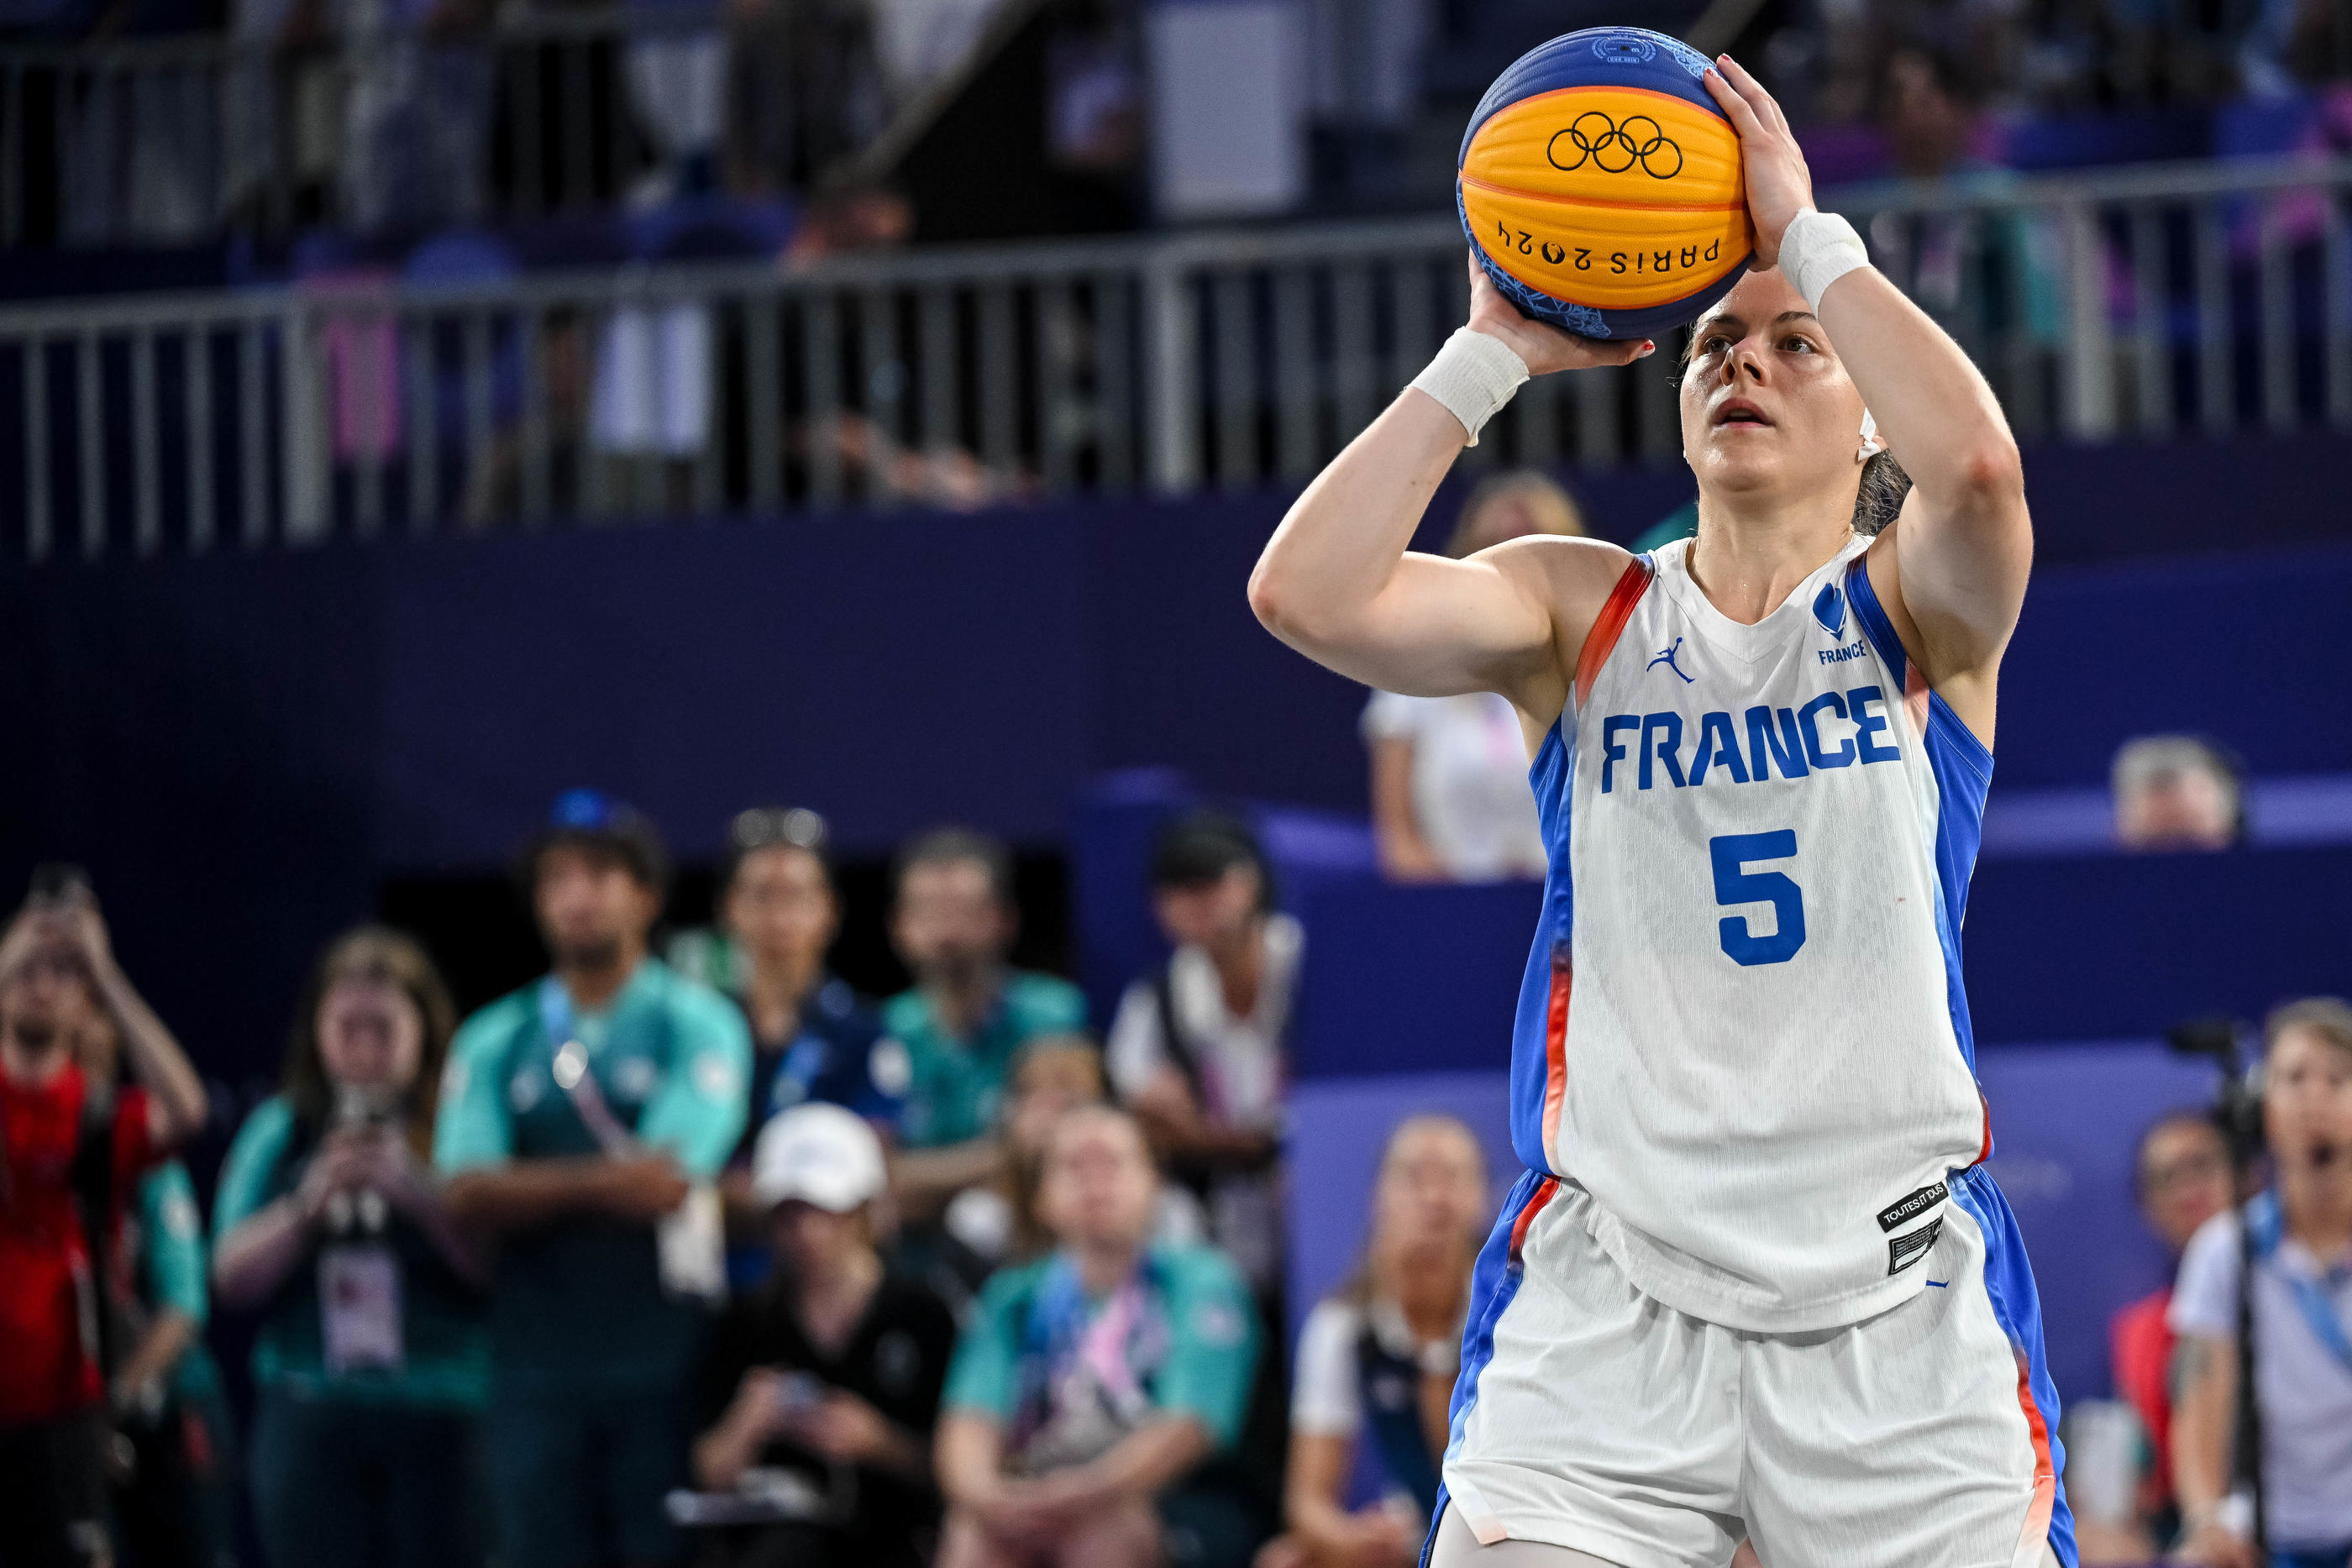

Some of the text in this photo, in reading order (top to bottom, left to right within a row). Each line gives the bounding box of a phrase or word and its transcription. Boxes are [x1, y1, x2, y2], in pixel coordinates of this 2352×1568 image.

[1498, 220, 1592, 270] 2024
[1818, 639, 1866, 665] FRANCE
[1601, 685, 1901, 794] FRANCE
[1709, 829, 1806, 967] 5
[1883, 1198, 1920, 1223] TOUTES
